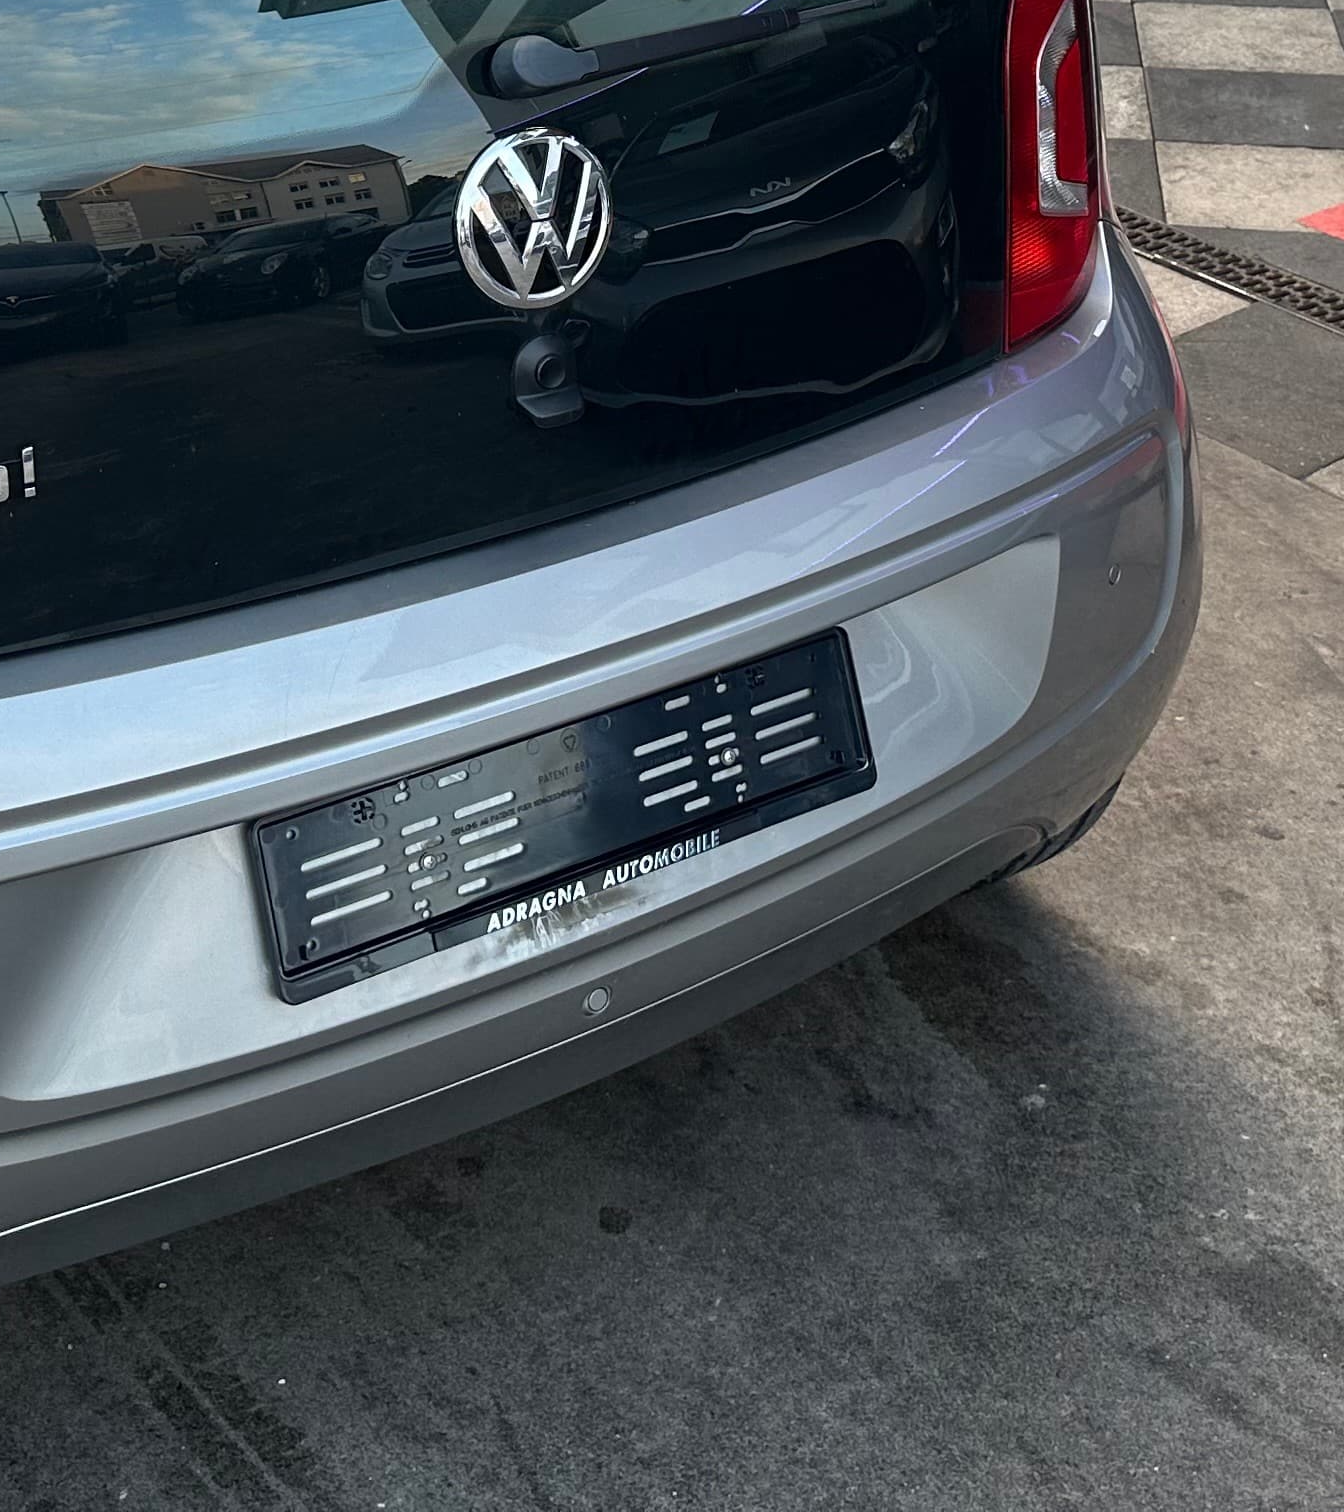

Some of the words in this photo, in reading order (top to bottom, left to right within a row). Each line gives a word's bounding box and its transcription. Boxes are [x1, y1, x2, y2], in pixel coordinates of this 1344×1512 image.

[456, 128, 612, 309] VW
[486, 880, 586, 934] ADRAGNA
[602, 828, 721, 890] AUTOMOBILE
